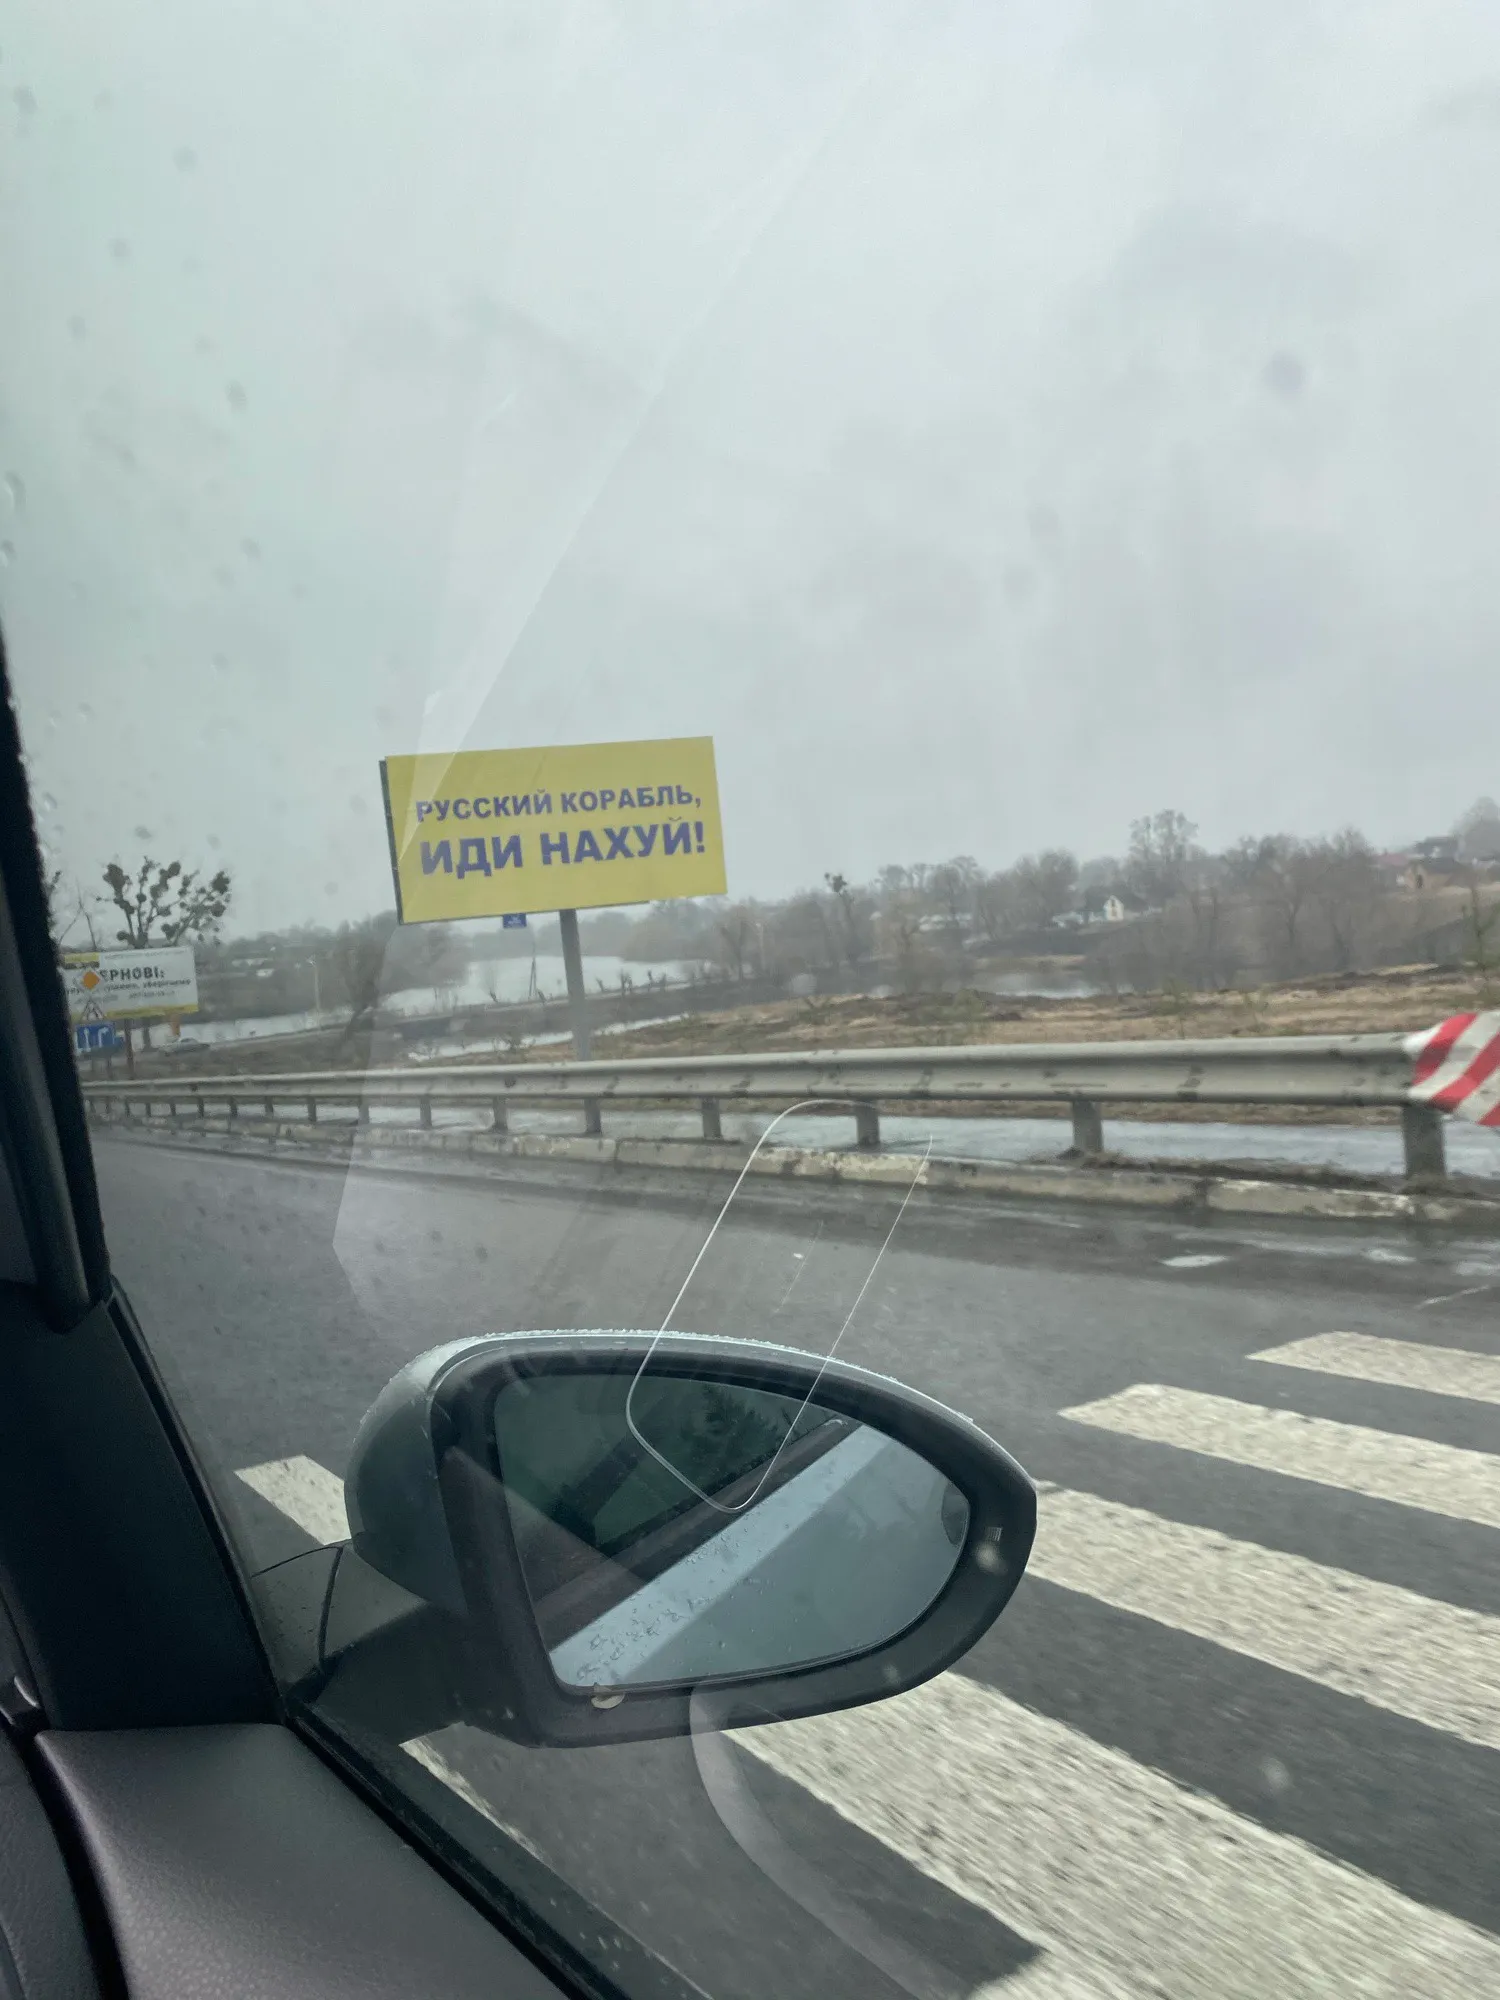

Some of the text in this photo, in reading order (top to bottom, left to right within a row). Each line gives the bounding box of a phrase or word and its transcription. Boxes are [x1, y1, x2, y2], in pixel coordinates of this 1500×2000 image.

[416, 785, 701, 822] РУССКИЙ КОРАБЛЬ,
[420, 816, 705, 879] ИДИ НАХУЙ!
